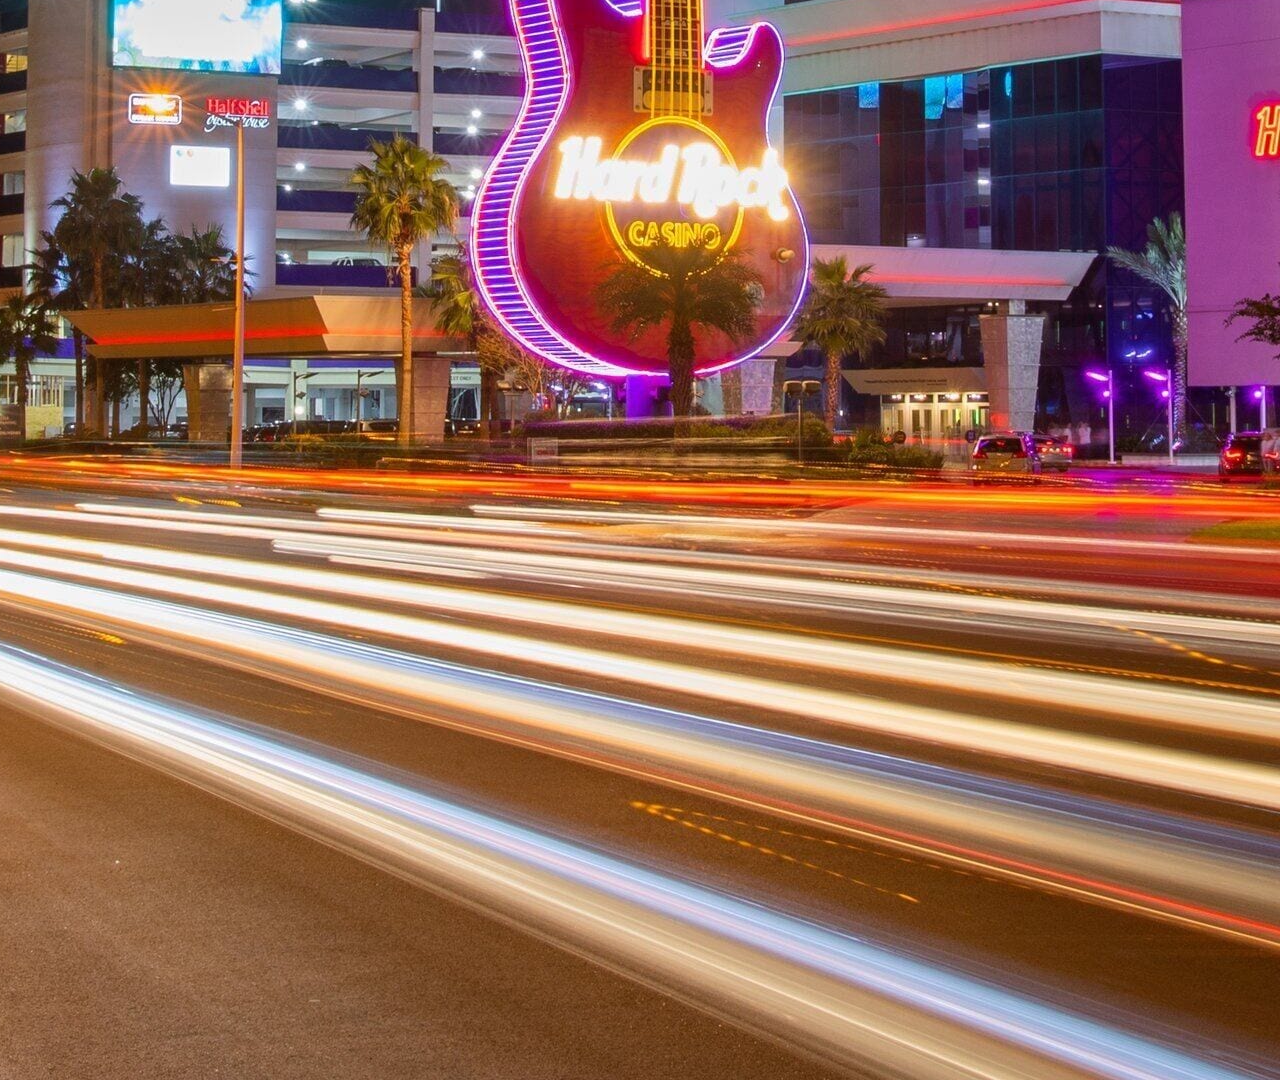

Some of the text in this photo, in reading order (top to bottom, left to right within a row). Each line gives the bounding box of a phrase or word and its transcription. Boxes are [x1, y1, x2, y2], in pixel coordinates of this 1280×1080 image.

[208, 98, 268, 116] Half Shell
[555, 136, 790, 222] Hard Rock
[628, 221, 721, 250] CASINO
